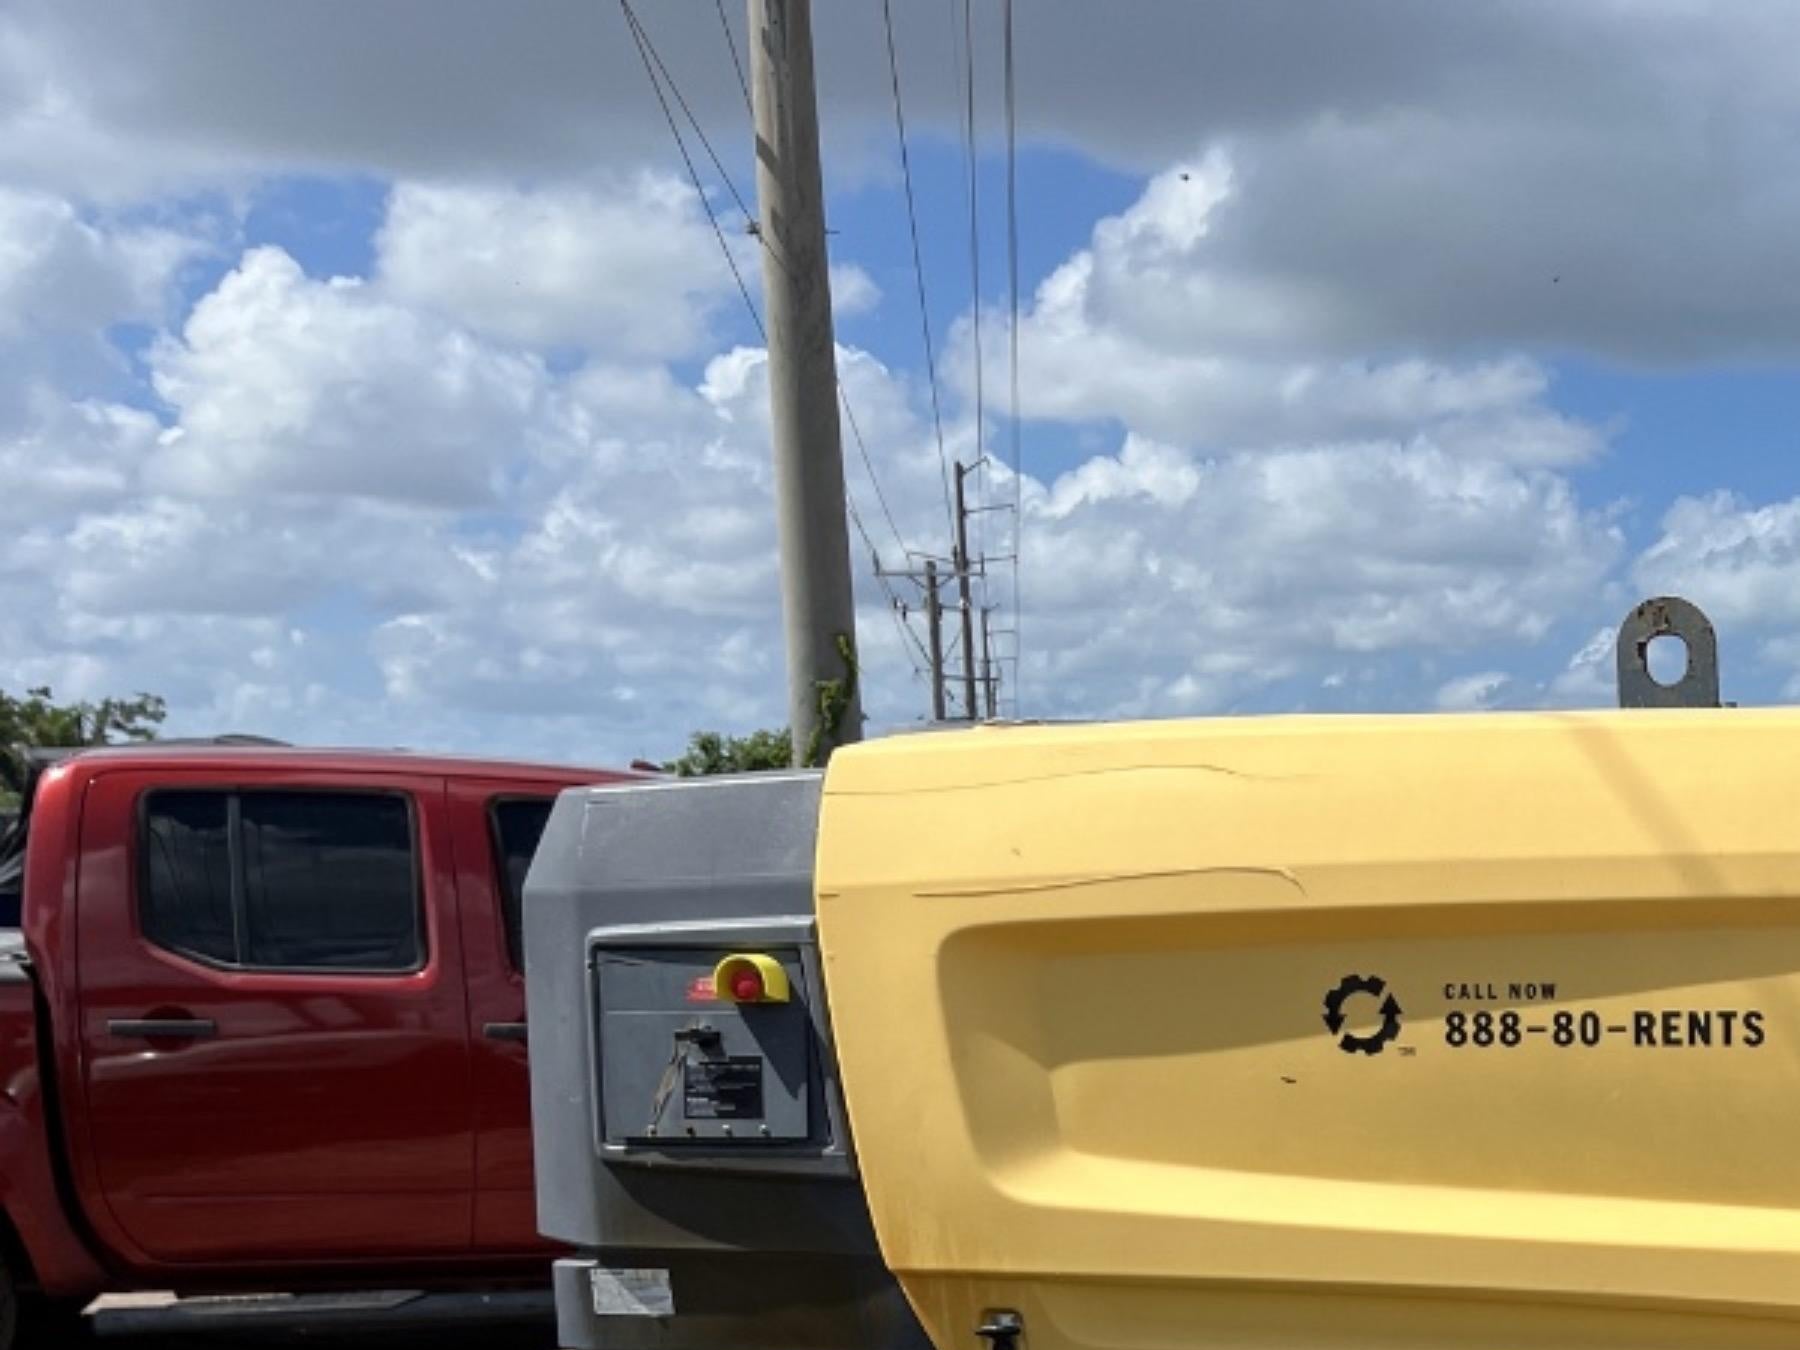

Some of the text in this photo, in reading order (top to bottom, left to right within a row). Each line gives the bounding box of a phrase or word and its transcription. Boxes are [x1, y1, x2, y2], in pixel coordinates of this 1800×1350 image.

[1444, 983, 1558, 1000] CALL NOW
[1444, 1010, 1766, 1048] 888-80-RENTS
